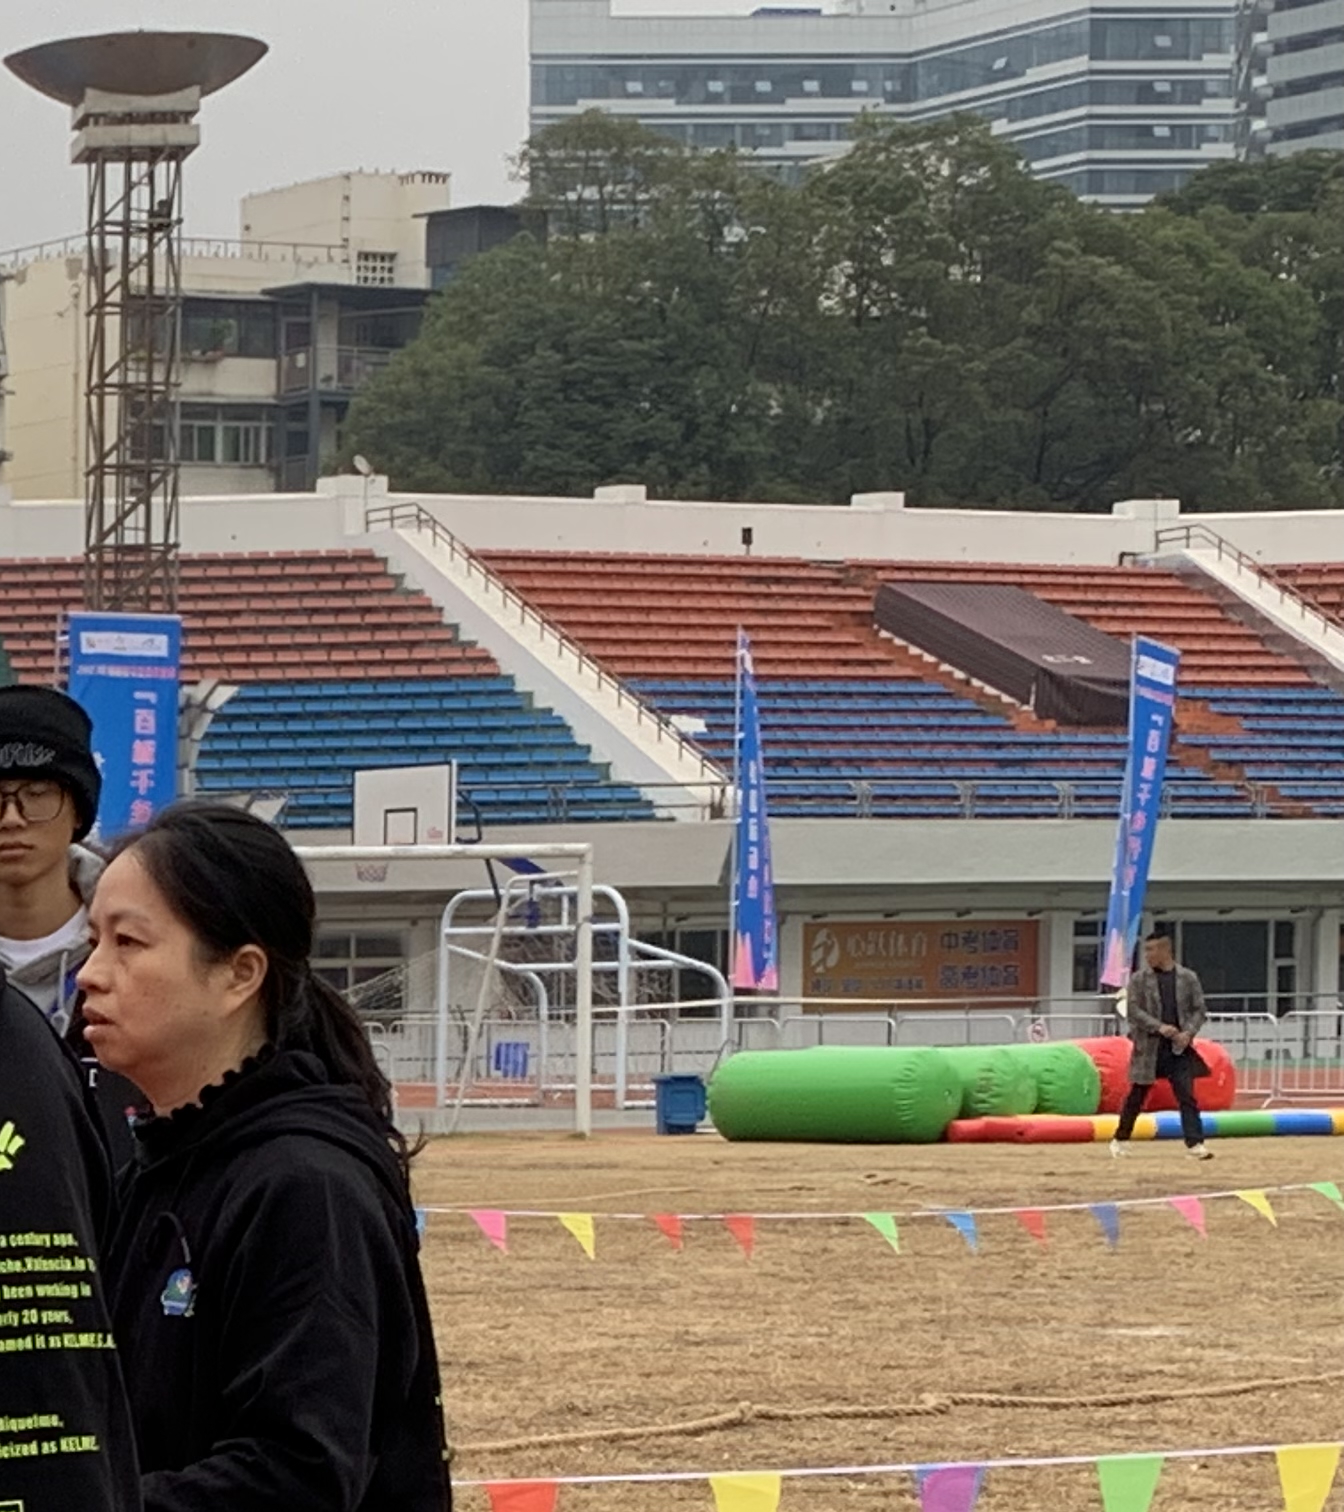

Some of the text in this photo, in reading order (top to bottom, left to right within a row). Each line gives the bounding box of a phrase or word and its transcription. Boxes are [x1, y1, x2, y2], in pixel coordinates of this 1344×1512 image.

[2, 1285, 33, 1299] been
[22, 1309, 38, 1324] 20
[41, 1441, 58, 1454] as
